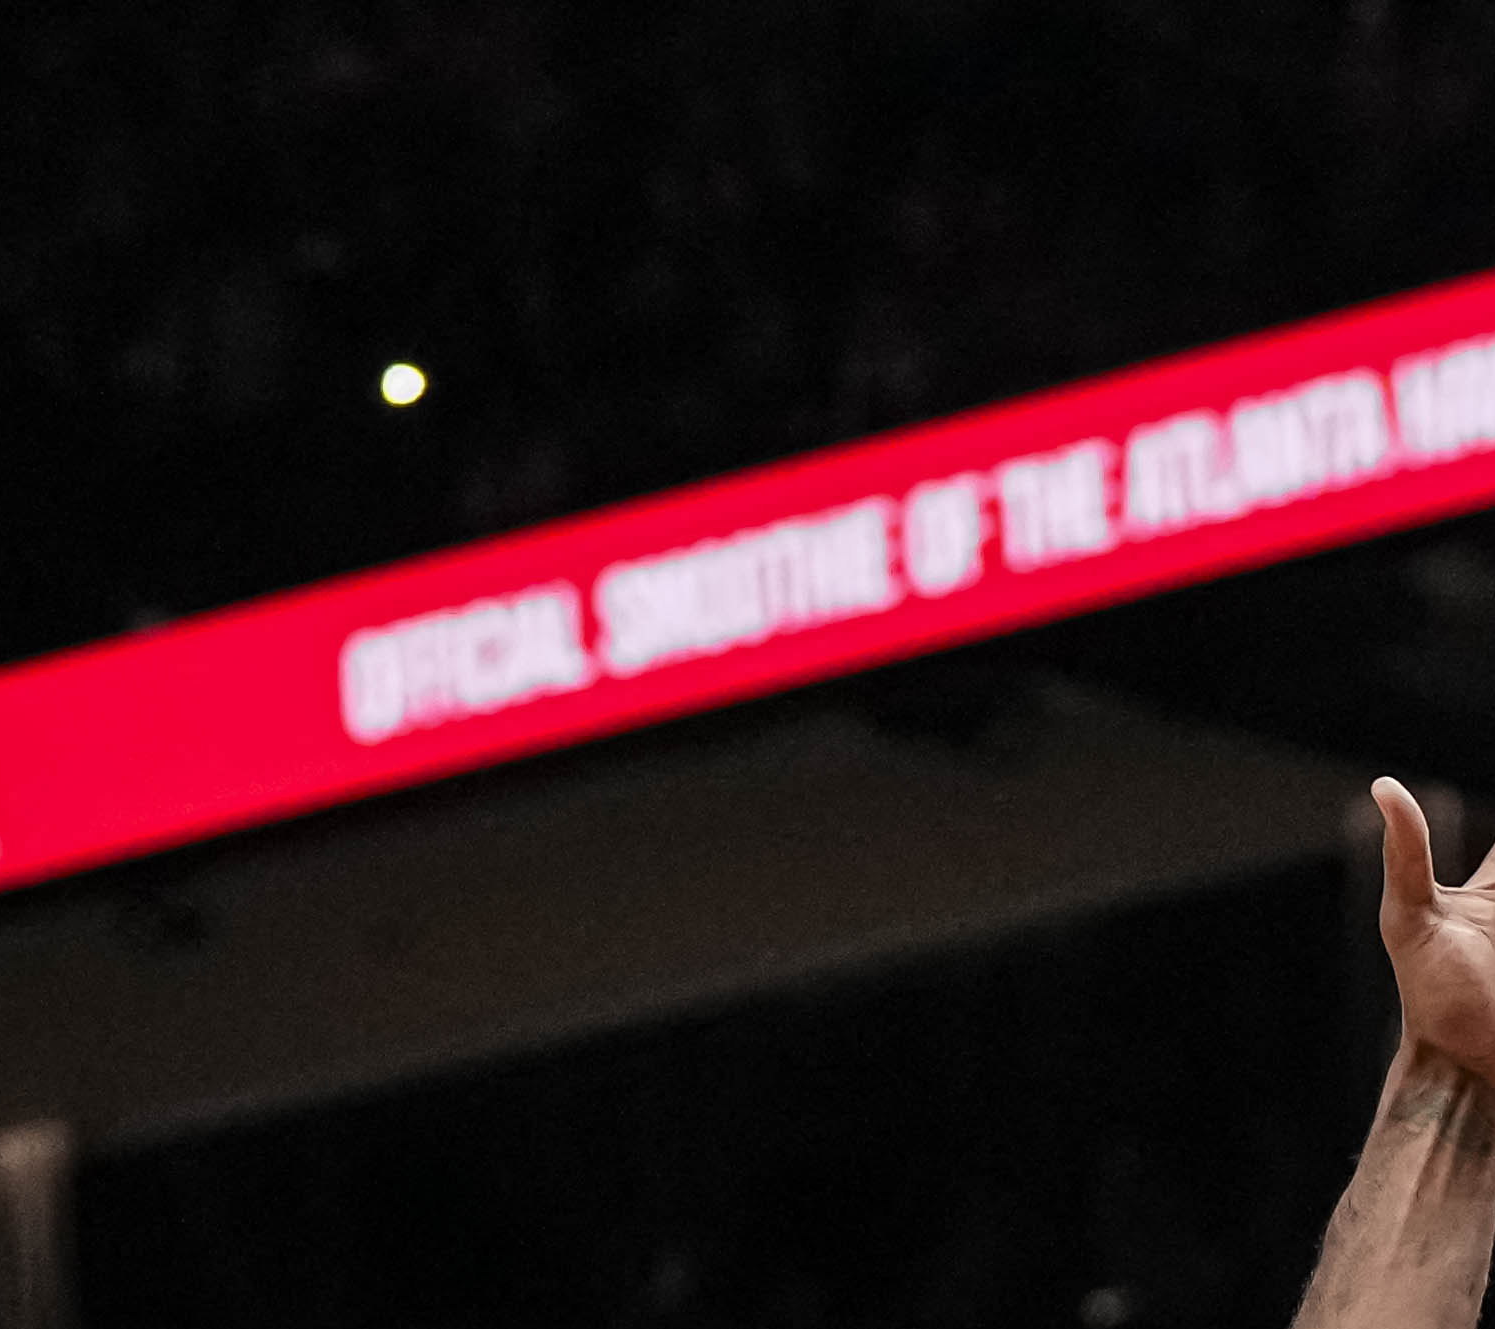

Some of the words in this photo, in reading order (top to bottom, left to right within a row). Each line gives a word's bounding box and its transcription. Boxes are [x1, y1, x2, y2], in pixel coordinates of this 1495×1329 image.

[342, 579, 591, 742] OFFICIAL
[597, 496, 899, 674] SMOOTHIE
[999, 442, 1115, 570] THE
[1124, 369, 1389, 537] ATLANTA
